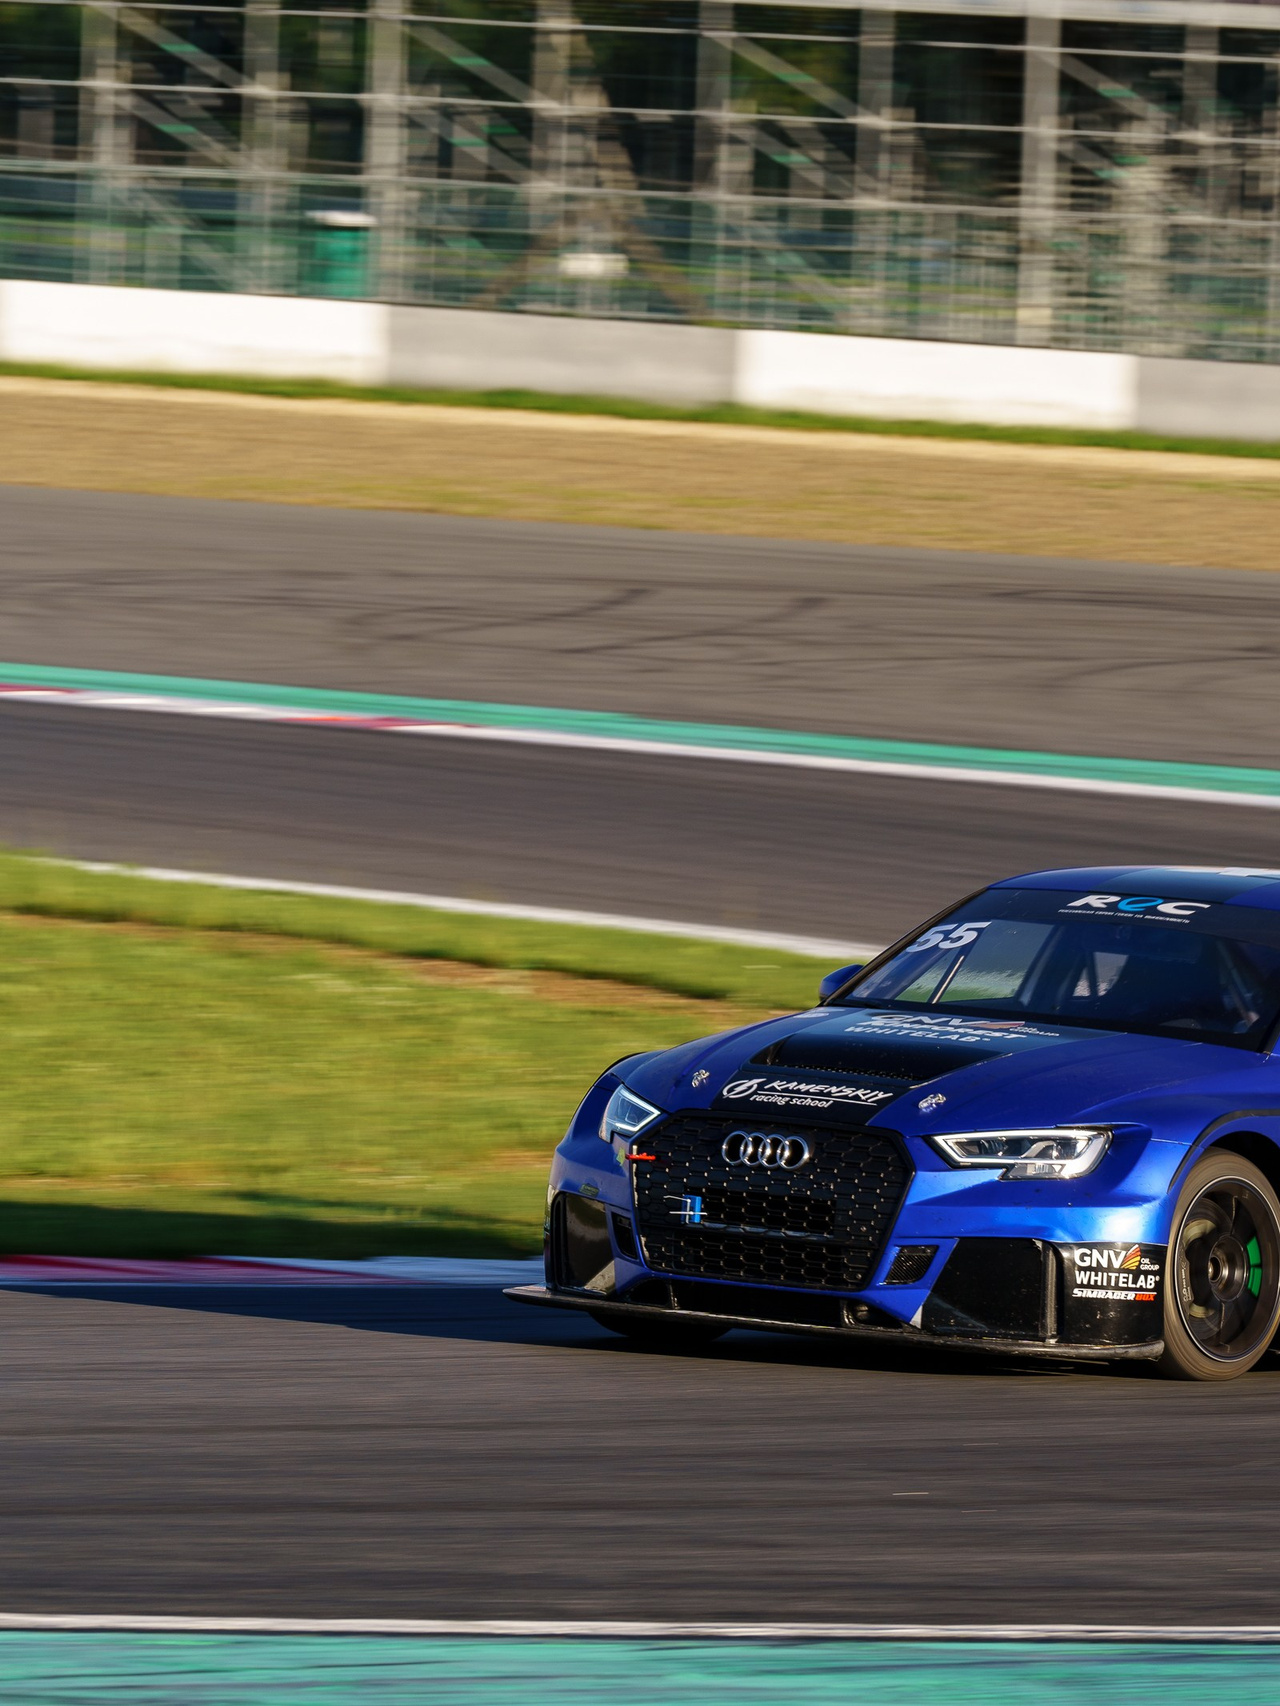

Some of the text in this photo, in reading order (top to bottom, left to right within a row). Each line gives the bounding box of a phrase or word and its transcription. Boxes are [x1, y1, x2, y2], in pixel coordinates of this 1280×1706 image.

[906, 921, 993, 953] 55
[750, 1093, 834, 1108] racing school
[764, 1080, 893, 1103] KAMENSKIY
[1074, 1248, 1127, 1268] GNV
